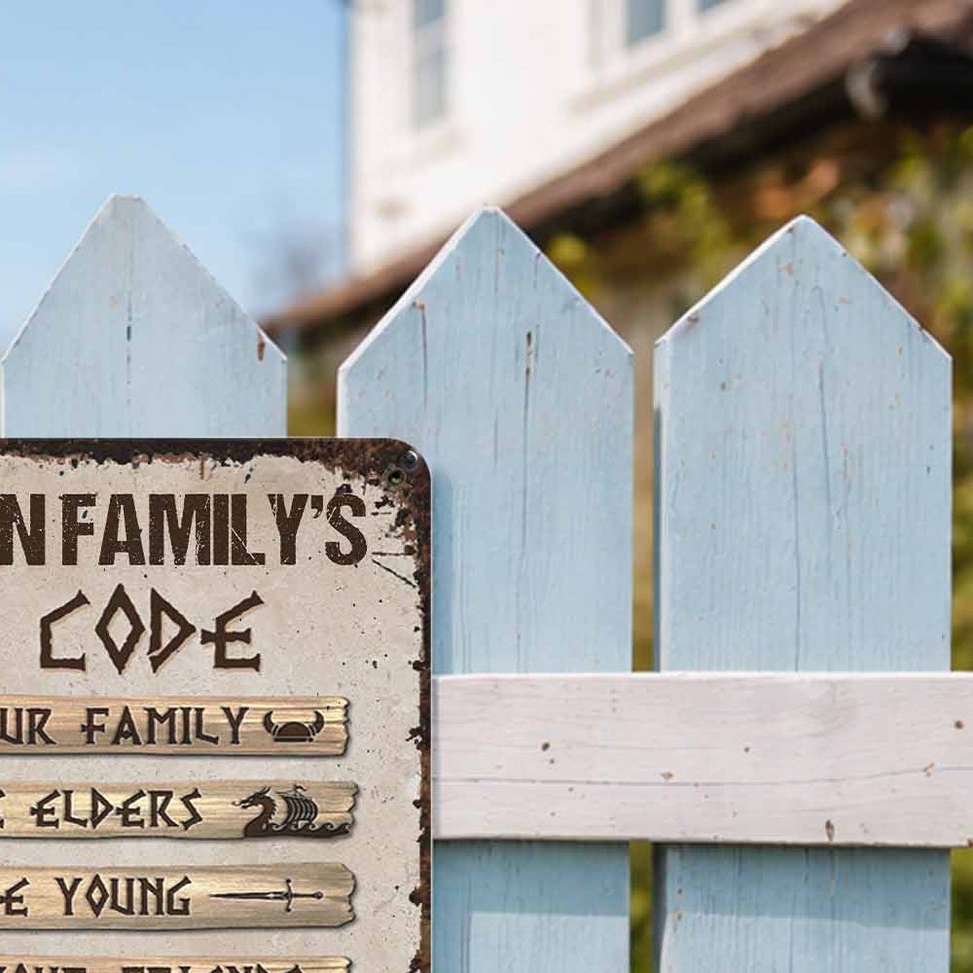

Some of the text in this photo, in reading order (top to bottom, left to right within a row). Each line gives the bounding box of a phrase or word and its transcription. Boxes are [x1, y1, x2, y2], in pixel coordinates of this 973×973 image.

[60, 493, 368, 566] FAMILY'S
[40, 583, 266, 674] CODE
[81, 705, 249, 747] FAMILY
[31, 788, 203, 830] ELDERS
[55, 875, 192, 918] YOUNG
